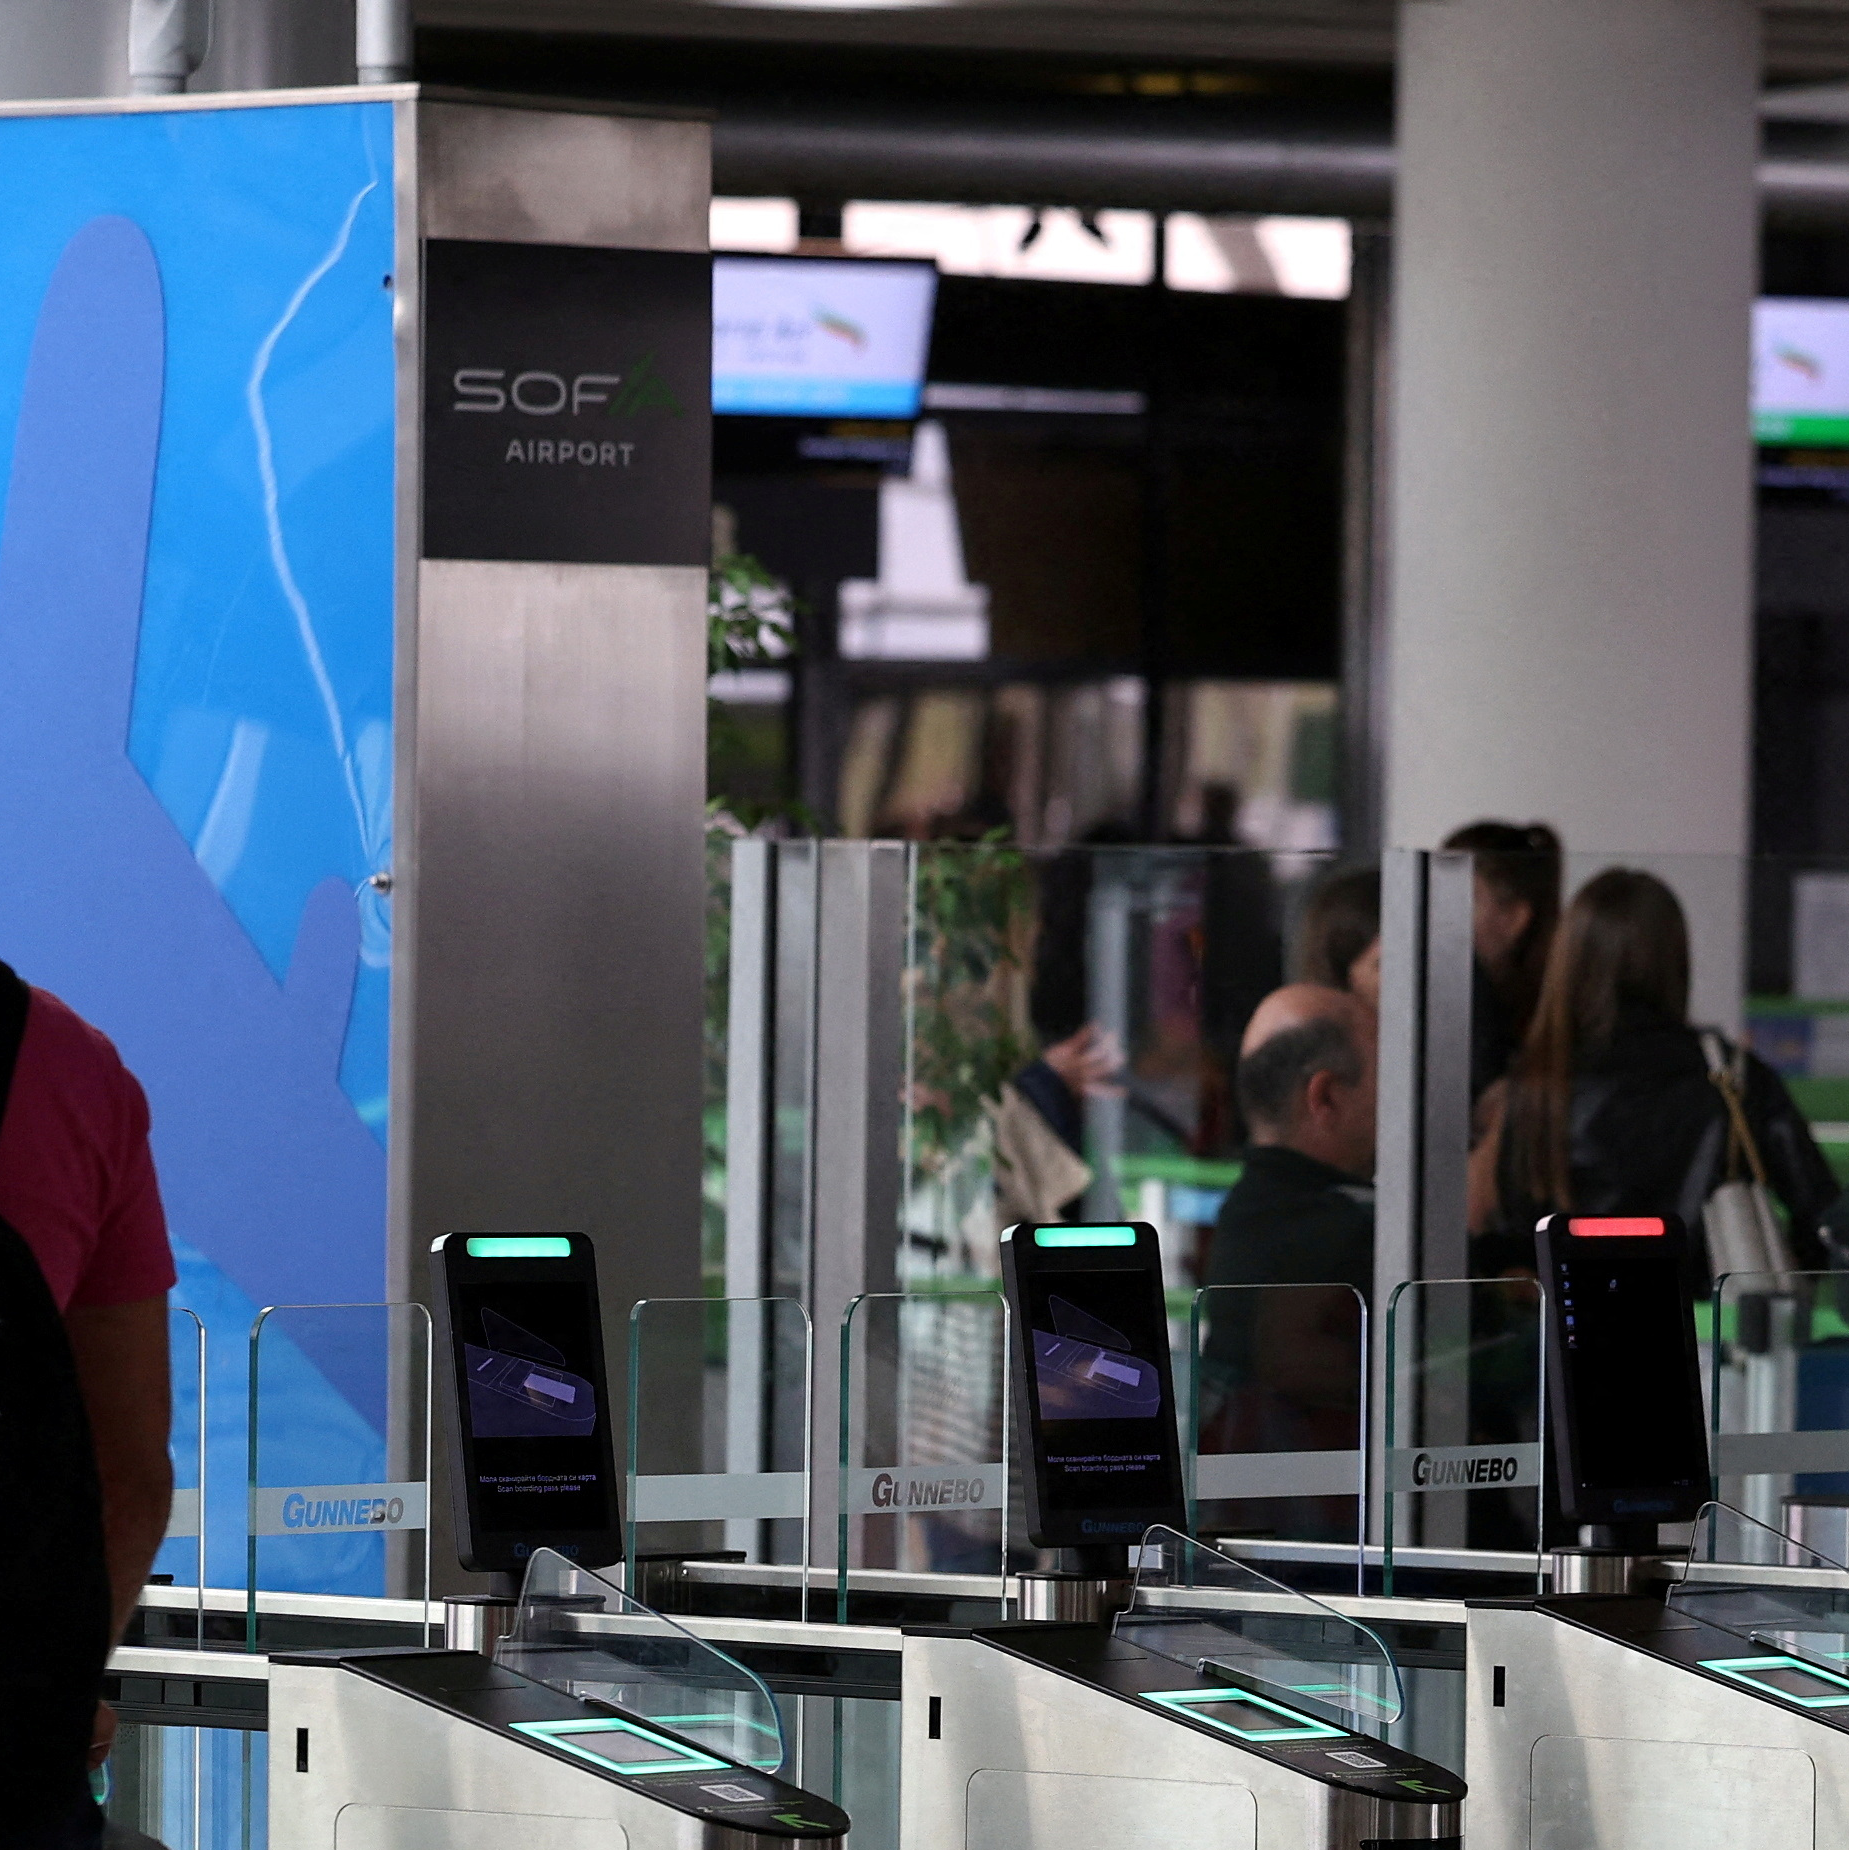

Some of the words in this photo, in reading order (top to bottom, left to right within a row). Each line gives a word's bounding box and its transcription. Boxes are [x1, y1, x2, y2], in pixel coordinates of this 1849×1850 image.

[452, 350, 685, 417] SOFIA
[505, 438, 635, 468] AIRPORT
[1412, 1453, 1518, 1486] GUNNEBO
[560, 1484, 581, 1492] please
[872, 1473, 985, 1507] GUNNEBO
[282, 1492, 404, 1528] GUNNEBO
